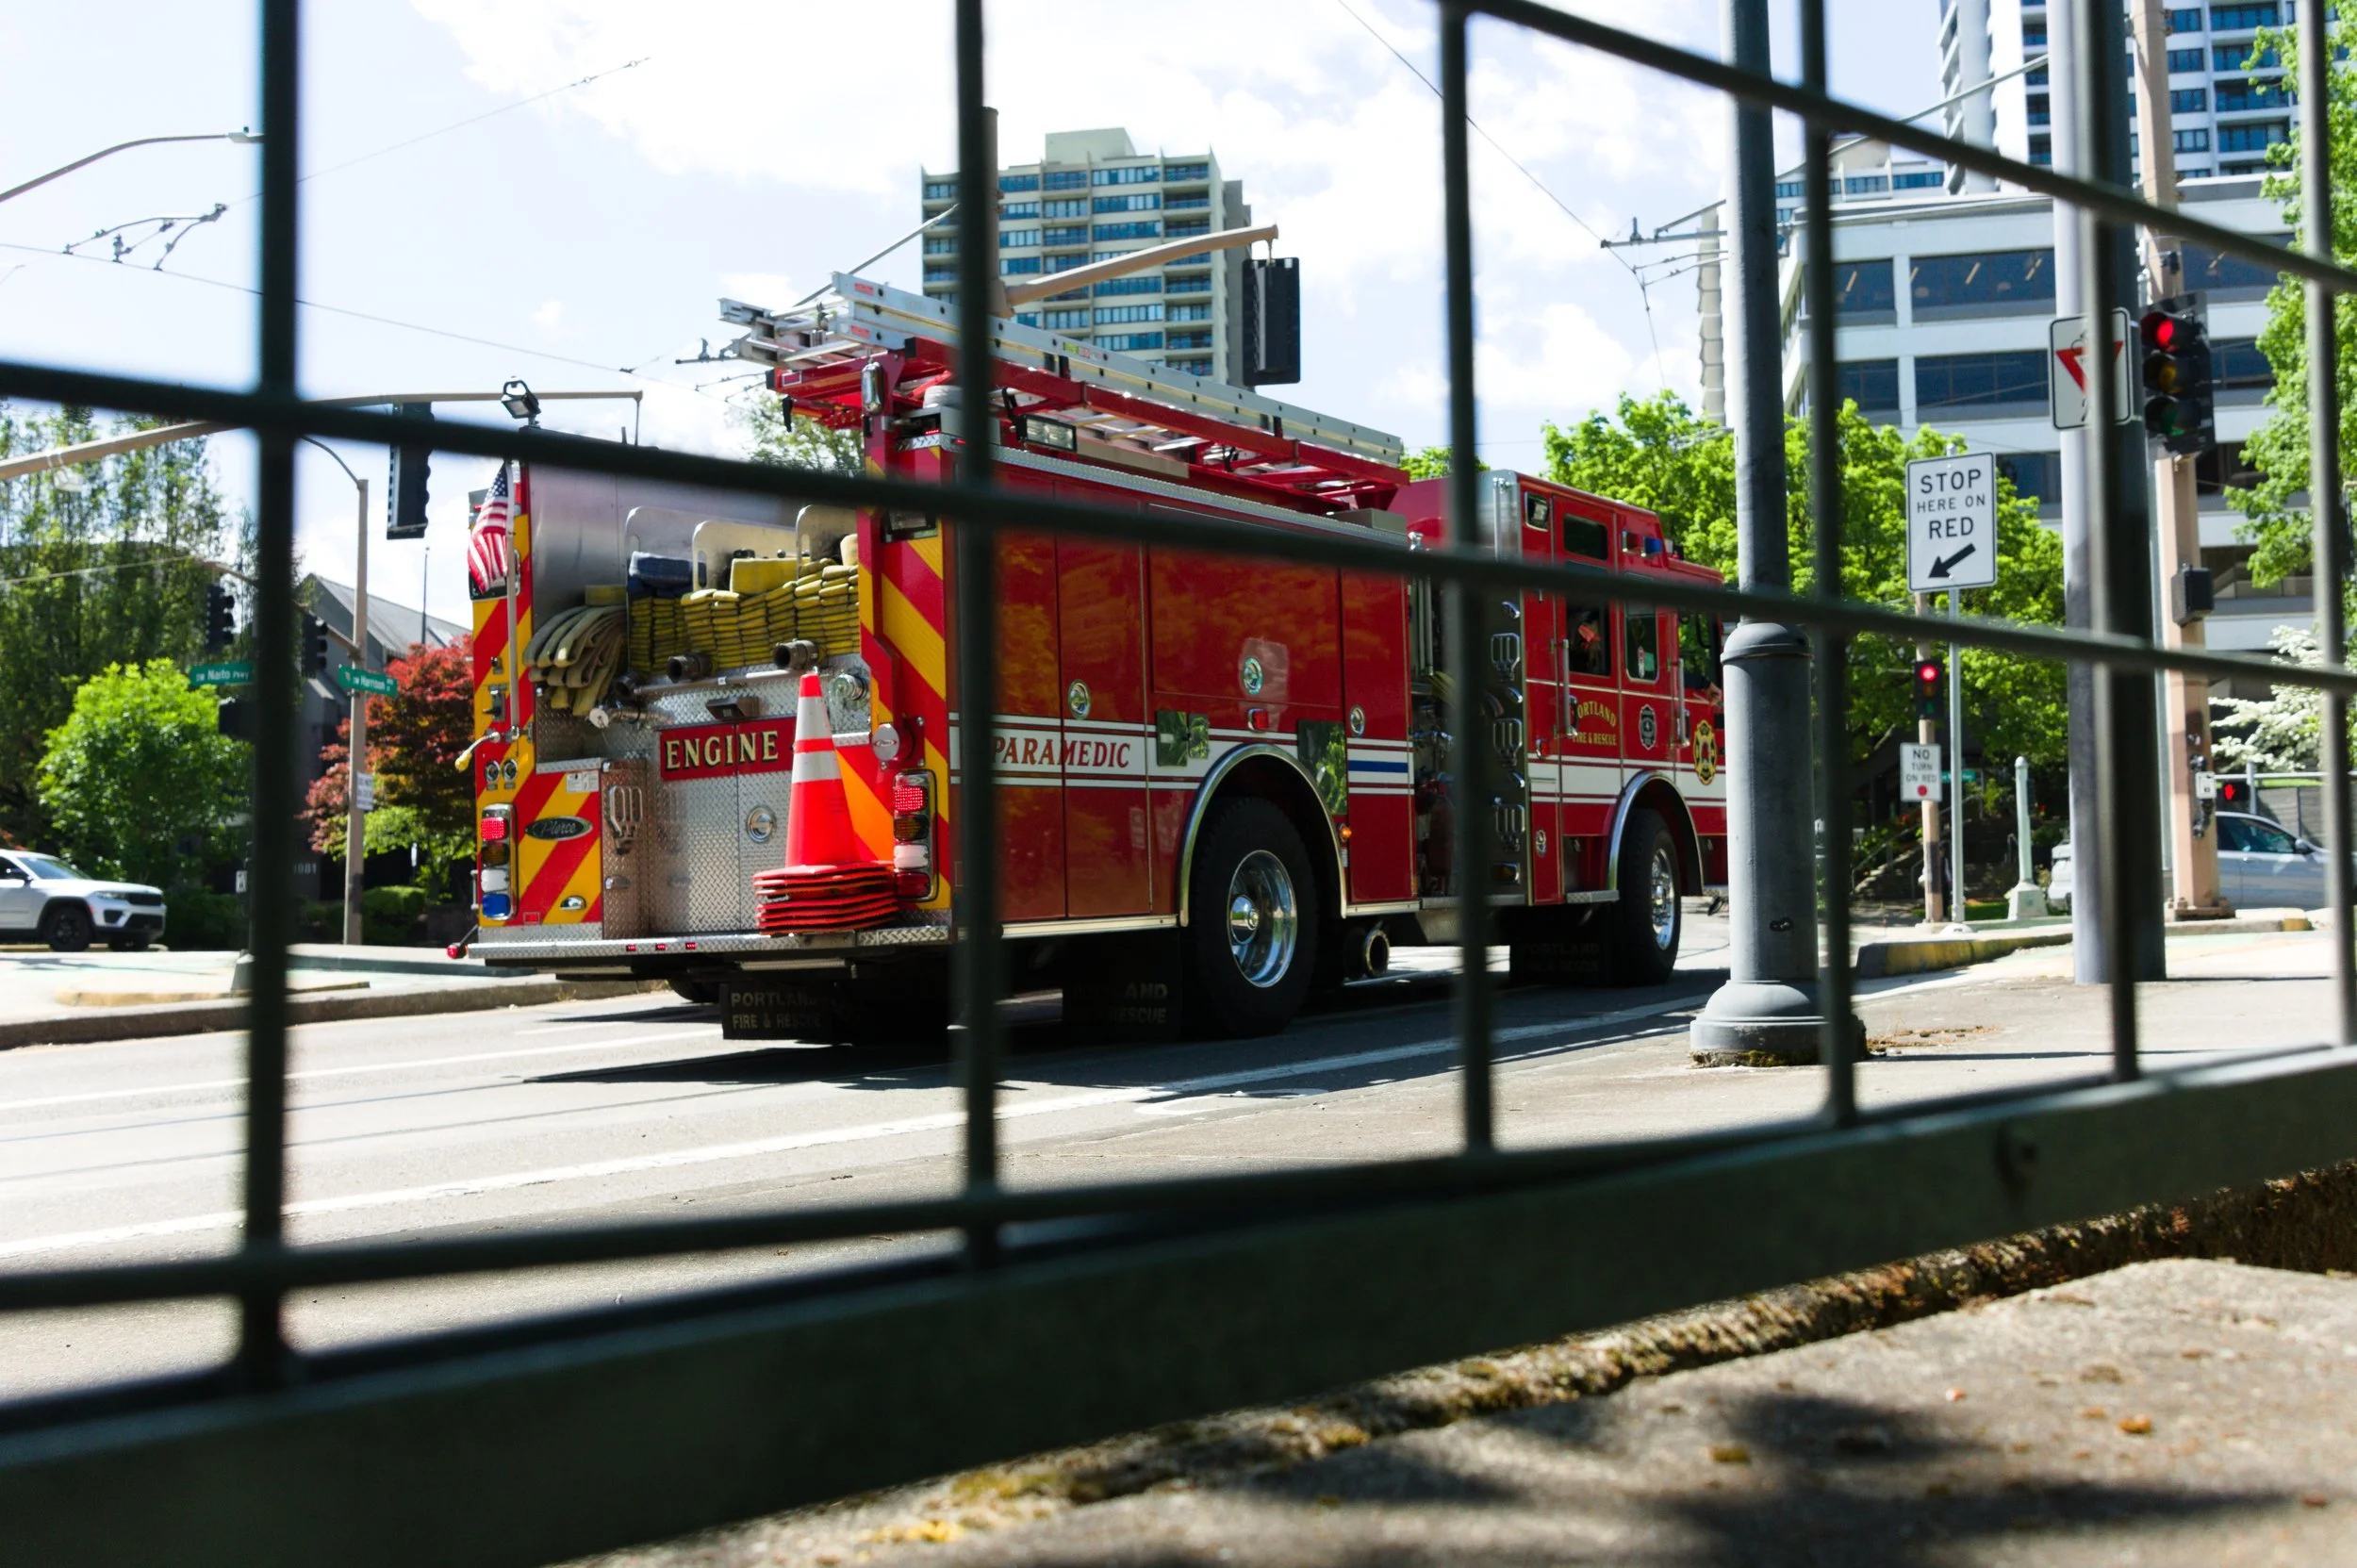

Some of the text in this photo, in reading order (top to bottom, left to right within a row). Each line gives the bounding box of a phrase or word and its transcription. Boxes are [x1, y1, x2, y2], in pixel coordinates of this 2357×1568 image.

[1920, 469, 1982, 494] STOP
[1917, 494, 1986, 513] HERE ON
[1929, 517, 1974, 539] RED
[207, 668, 231, 681] Naito
[1577, 701, 1617, 728] ORTLAND
[1593, 733, 1618, 746] RESCUE
[664, 730, 780, 770] ENGINE
[993, 735, 1130, 768] PARAMEDIC
[1912, 749, 1931, 760] NO
[1911, 762, 1934, 770] TURN
[1904, 773, 1918, 783] ON
[1921, 773, 1938, 783] RED
[732, 1013, 759, 1030] FIRE
